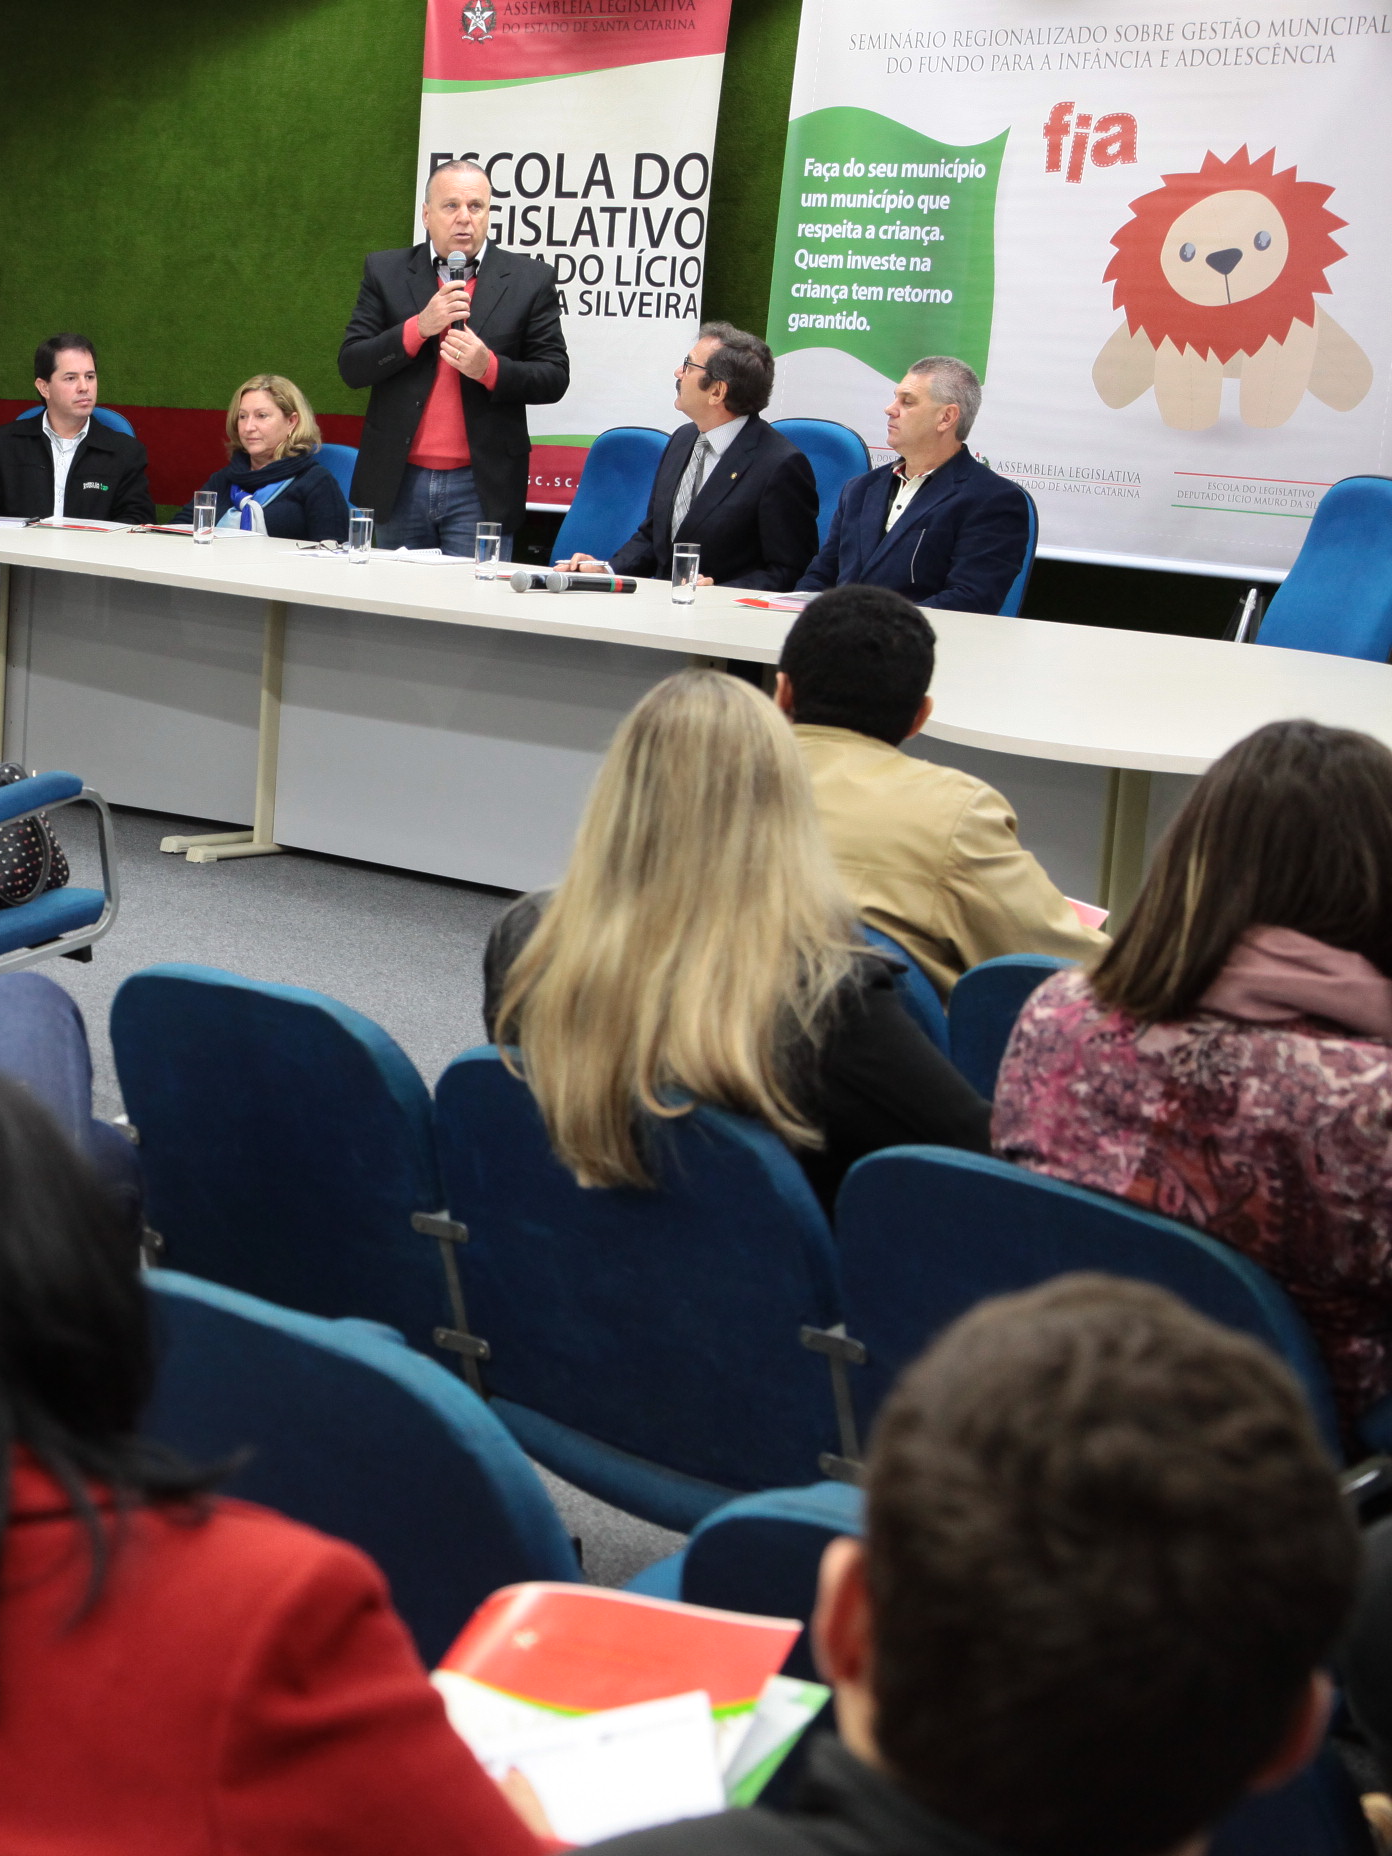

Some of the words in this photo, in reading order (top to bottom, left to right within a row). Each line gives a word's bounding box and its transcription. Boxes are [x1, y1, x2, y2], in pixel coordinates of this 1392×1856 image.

[504, 0, 593, 15] ASSEMBLEIA
[599, 0, 696, 13] LEGISLATIVA
[502, 23, 520, 34] DO
[524, 22, 569, 34] ESTADO
[573, 21, 588, 33] DE
[592, 20, 630, 32] SANTA
[633, 19, 696, 31] CATARINA
[848, 29, 947, 51] SEMINÁRIO
[952, 25, 1108, 48] REGIONALIZADO
[1113, 23, 1175, 43] SOBRE
[1181, 17, 1261, 41] GESTÃO
[1268, 14, 1391, 38] MUNICIPAL
[886, 56, 913, 74] DO
[918, 55, 985, 74] FUNDO
[990, 53, 1035, 72] PARA
[1039, 53, 1052, 71] A
[1058, 47, 1153, 71] INFÂNCIA
[1160, 49, 1170, 68] E
[1175, 43, 1337, 68] ADOLESCÊNCIA
[633, 152, 709, 200] DO
[804, 158, 840, 182] Faça
[843, 158, 865, 178] do
[868, 163, 898, 178] seu
[901, 158, 986, 183] município
[801, 192, 827, 207] um
[830, 189, 914, 213] município
[917, 194, 950, 214] que
[797, 219, 862, 242] respeita
[865, 225, 875, 239] a
[878, 220, 945, 246] criança.
[615, 248, 702, 289] LÍCIO
[794, 249, 844, 269] Quem
[847, 250, 907, 270] investe
[909, 257, 931, 271] na
[791, 279, 848, 303] criança
[852, 283, 883, 301] tem
[887, 285, 953, 304] retorno
[578, 290, 699, 320] SILVEIRA
[788, 311, 871, 332] garantido.
[996, 461, 1065, 476] ASSEMBLEIA
[1069, 467, 1141, 483] LEGISLATIVA
[1048, 481, 1061, 492] DE
[1063, 483, 1092, 495] SANTA
[1094, 486, 1141, 499] CATARINA
[1177, 490, 1225, 500] DEPUTADO
[1254, 497, 1288, 507] MAURO
[1290, 500, 1303, 508] DA
[1208, 482, 1240, 493] ESCOLA
[1242, 485, 1257, 494] DO
[1259, 486, 1315, 498] LEGISLATIVO
